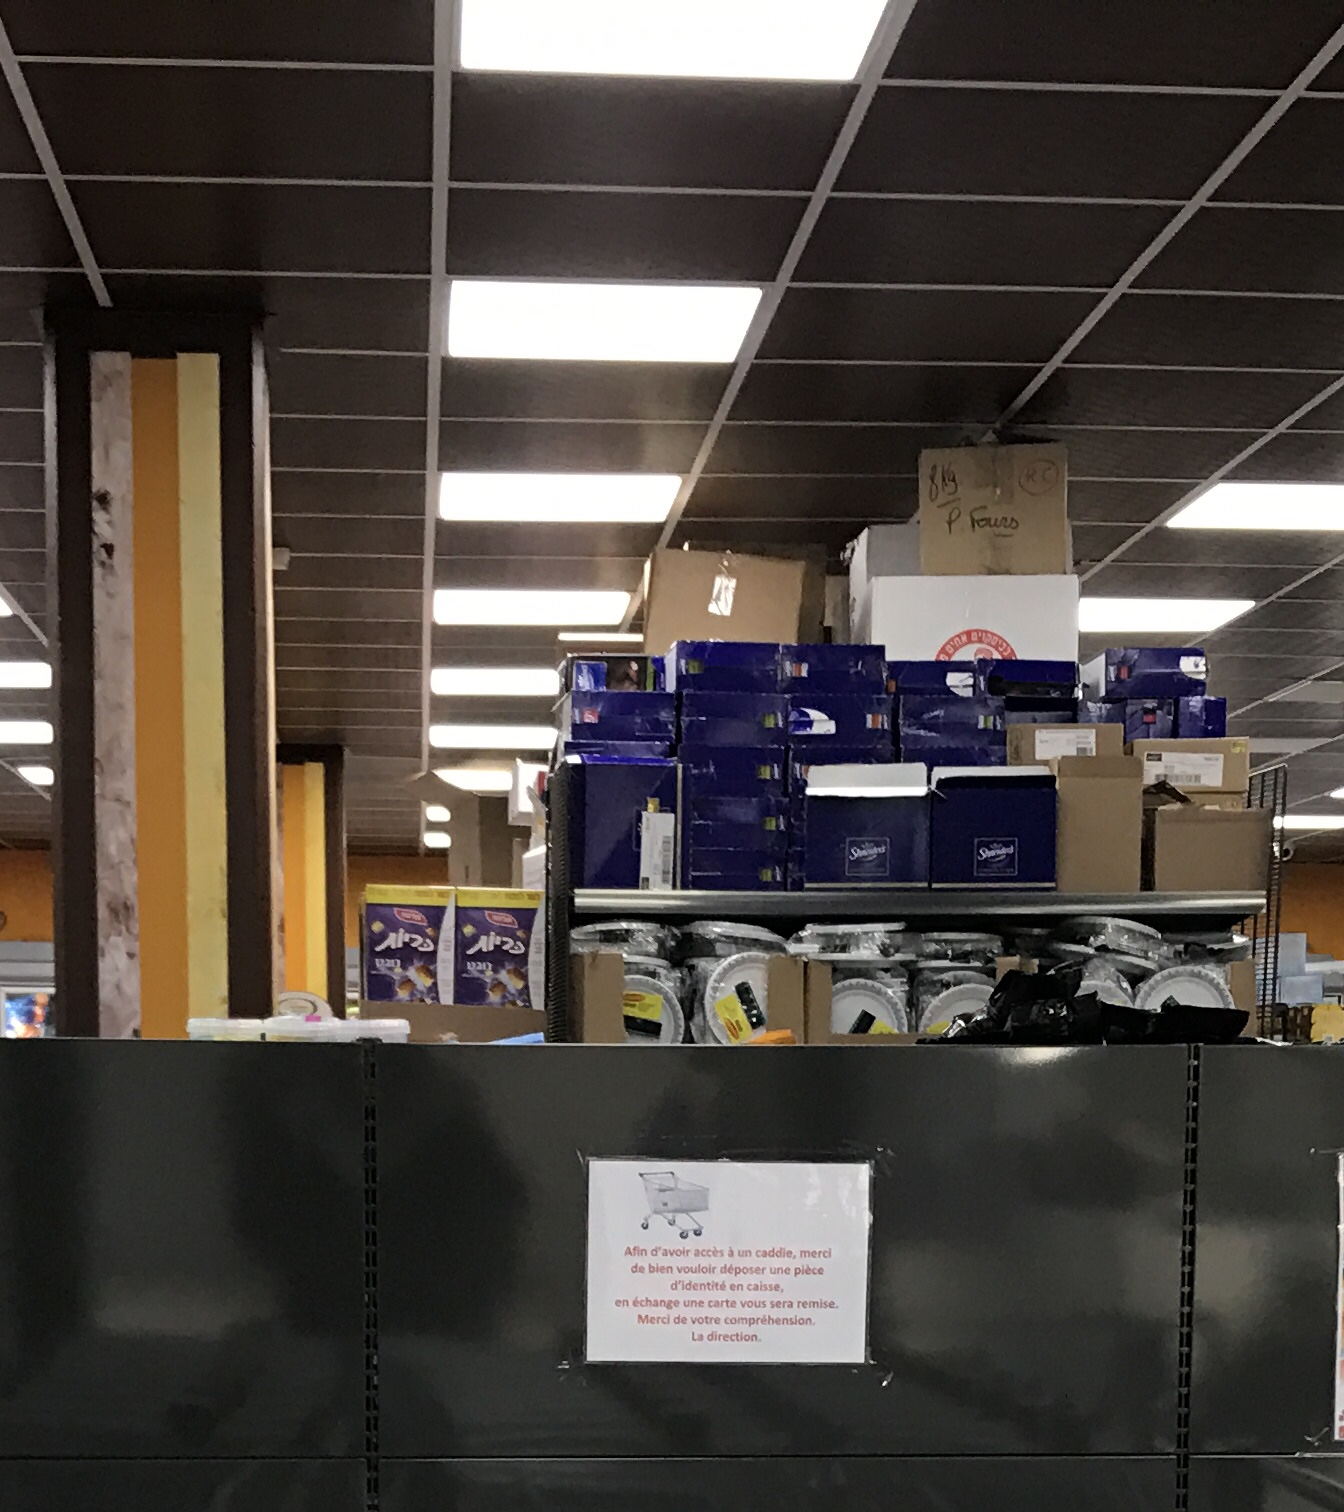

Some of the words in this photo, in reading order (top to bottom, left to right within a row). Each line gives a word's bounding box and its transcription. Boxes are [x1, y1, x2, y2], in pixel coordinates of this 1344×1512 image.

[624, 1246, 647, 1257] Afin
[651, 1246, 690, 1257] d'avoir
[694, 1247, 723, 1258] accès
[728, 1246, 734, 1258] à
[738, 1250, 751, 1258] un
[755, 1247, 796, 1259] caddie,
[800, 1248, 832, 1259] merci
[631, 1264, 645, 1274] de
[649, 1263, 672, 1274] bien
[677, 1264, 716, 1274] vouloir
[720, 1264, 766, 1277] déposer
[770, 1267, 791, 1275] une
[794, 1265, 824, 1277] pièce
[670, 1280, 726, 1291] d'identité
[730, 1283, 743, 1291] en
[747, 1282, 784, 1293] caisse,
[615, 1299, 629, 1307] en
[632, 1297, 680, 1310] échange
[684, 1300, 704, 1308] une
[708, 1299, 736, 1308] carte
[740, 1300, 766, 1309] vous
[770, 1301, 793, 1309] sera
[797, 1299, 839, 1309] remise.
[637, 1314, 670, 1325] Merci
[673, 1314, 687, 1325] de
[690, 1316, 720, 1325] votre
[724, 1314, 815, 1327] compréhension.
[692, 1331, 703, 1342] La
[707, 1331, 761, 1342] direction.
